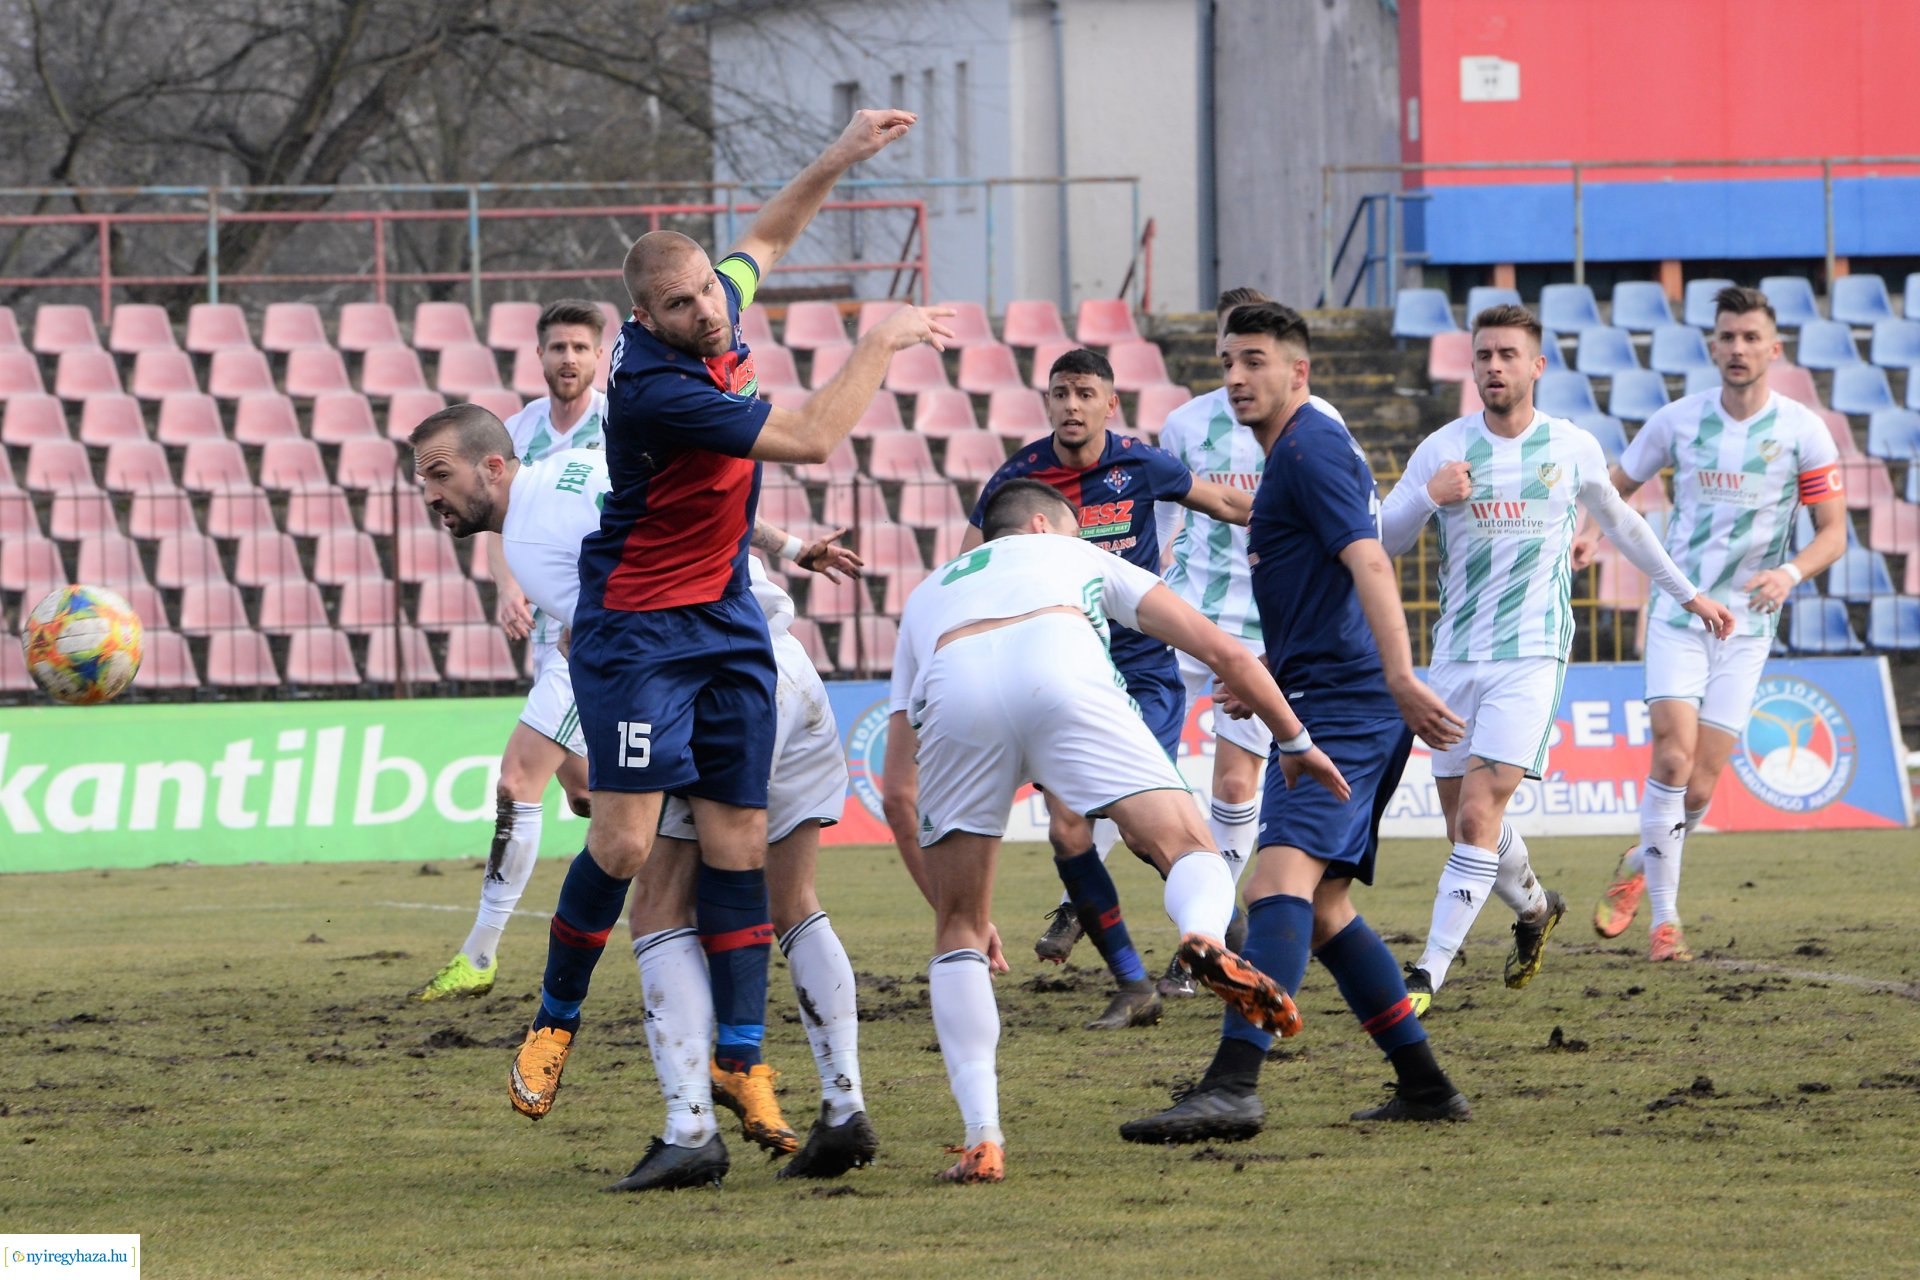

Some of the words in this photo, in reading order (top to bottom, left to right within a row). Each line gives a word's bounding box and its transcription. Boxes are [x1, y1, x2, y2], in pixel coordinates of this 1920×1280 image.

[555, 462, 594, 494] FEJES
[1471, 502, 1526, 519] WKW
[1477, 516, 1544, 528] automotive
[617, 721, 652, 768] 15
